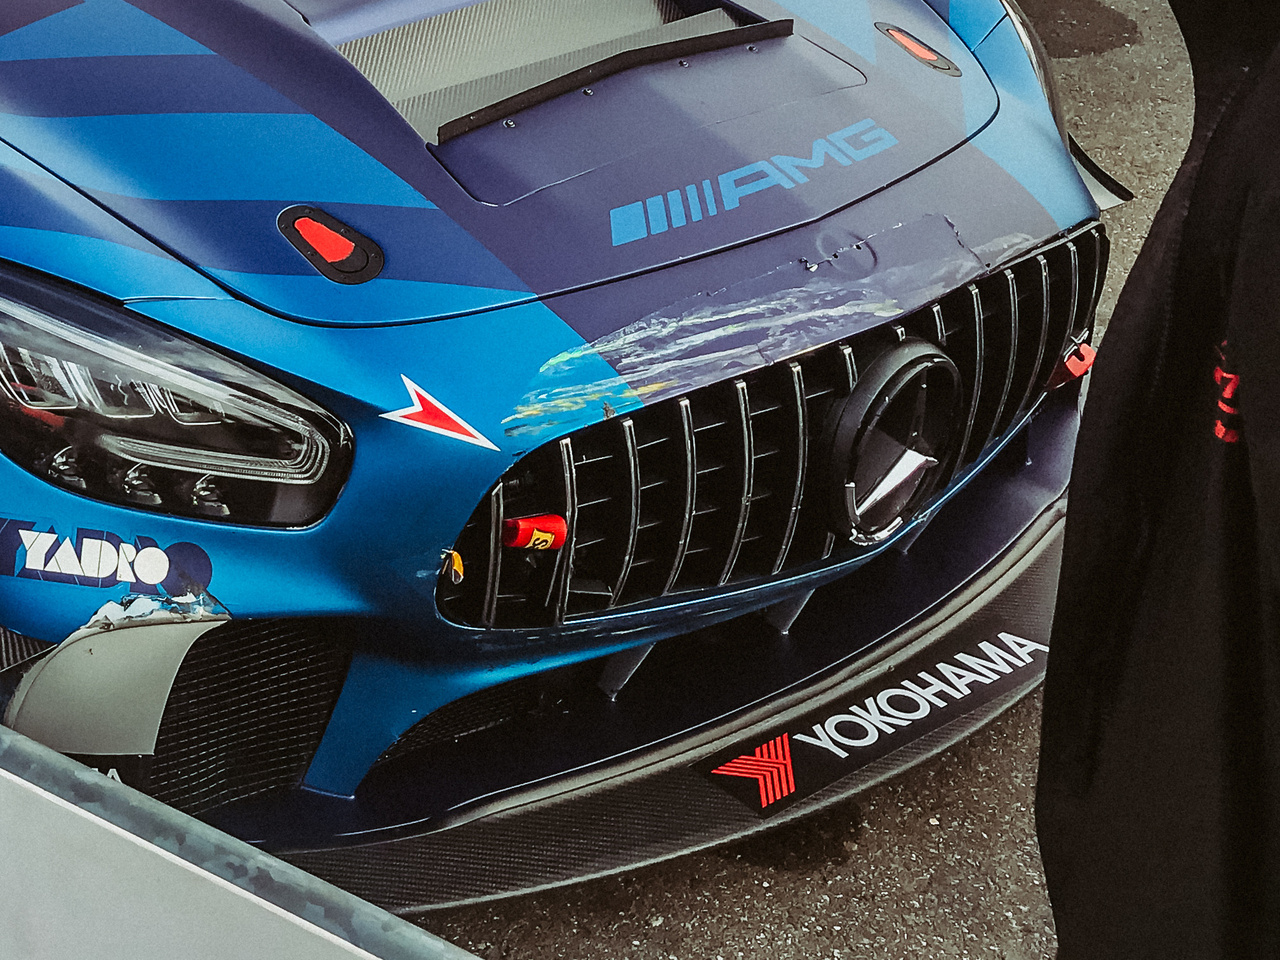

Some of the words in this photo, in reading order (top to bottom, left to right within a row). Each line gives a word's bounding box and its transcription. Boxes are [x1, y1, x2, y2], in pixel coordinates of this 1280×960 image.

[719, 117, 900, 211] AMG
[18, 529, 170, 585] YADRO
[793, 631, 1050, 759] YOKOHAMA
